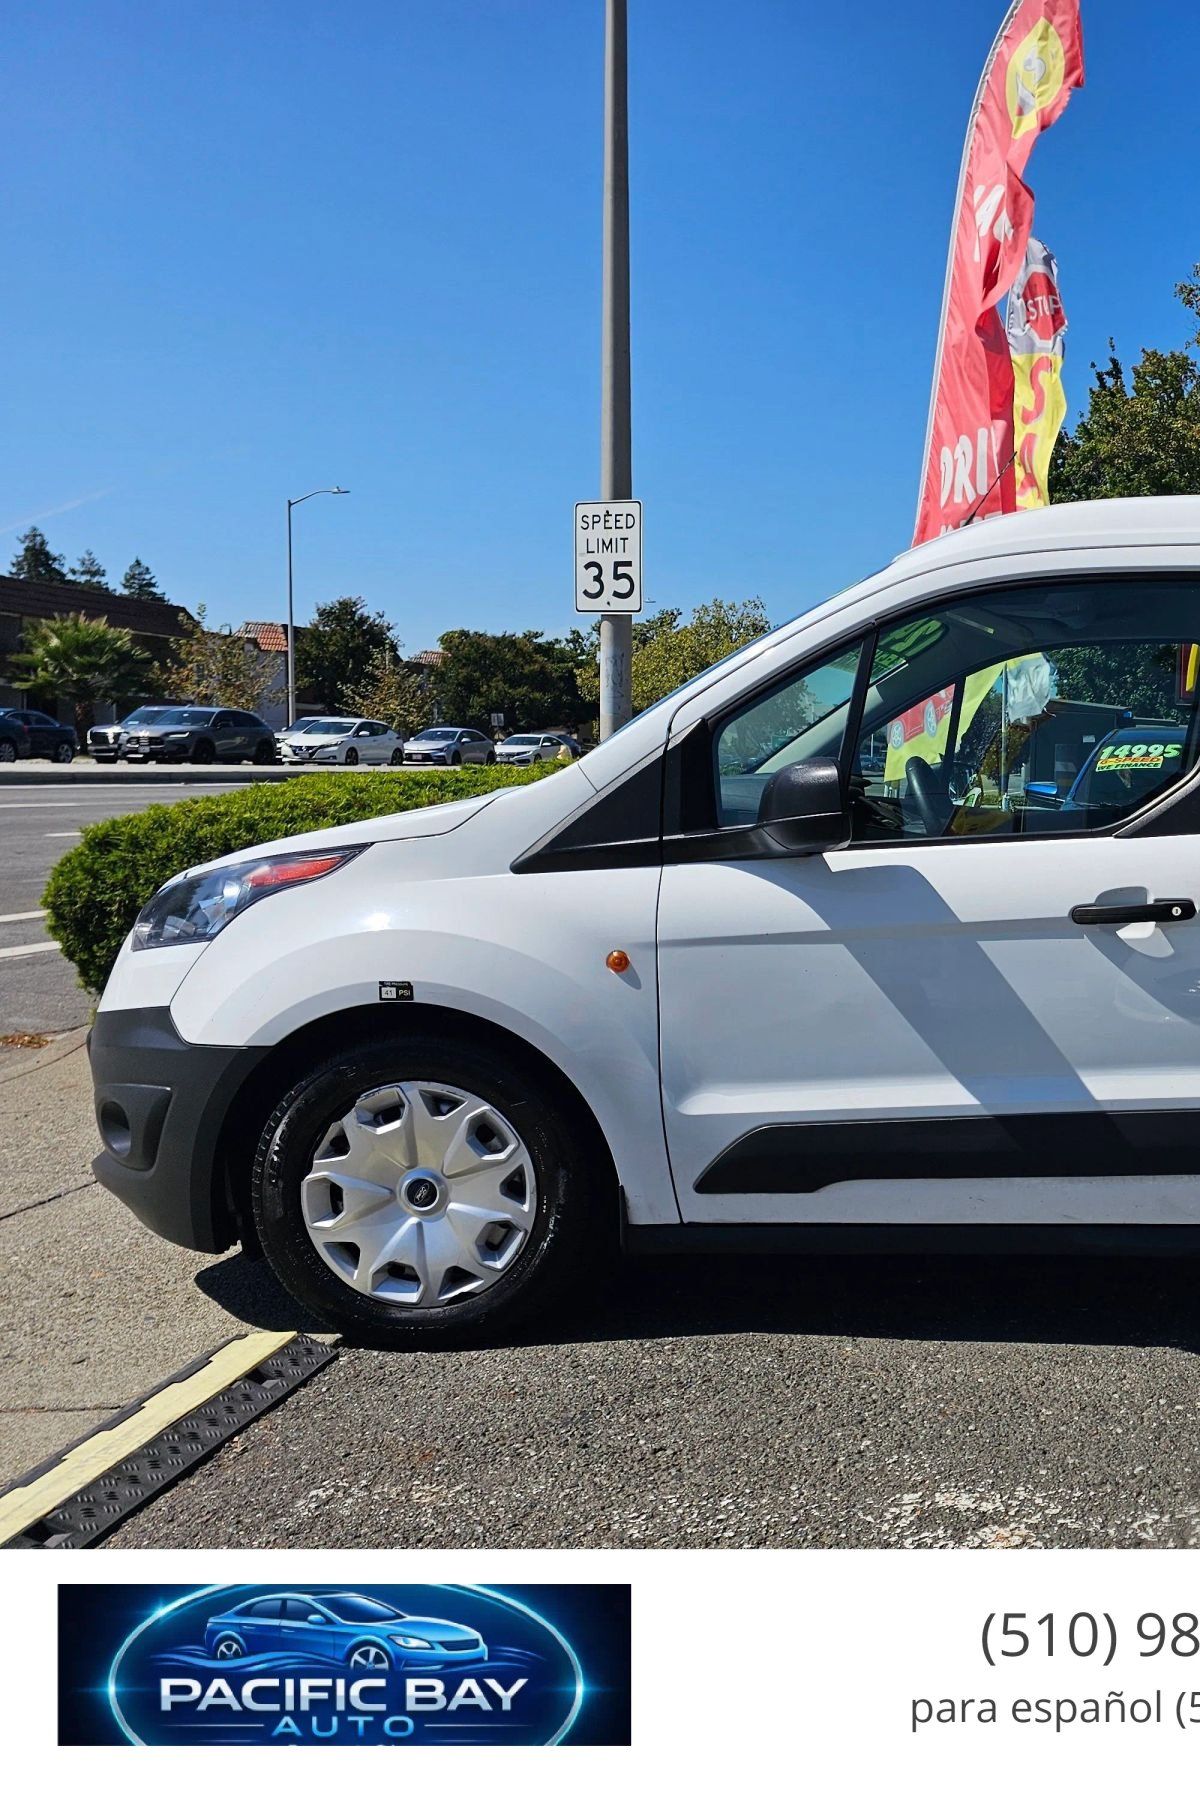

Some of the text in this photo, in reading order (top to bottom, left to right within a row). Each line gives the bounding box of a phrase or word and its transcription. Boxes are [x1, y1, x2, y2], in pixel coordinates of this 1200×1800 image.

[580, 513, 636, 530] SPEED
[586, 537, 629, 554] LIMIT
[582, 560, 635, 600] 35
[1099, 744, 1182, 760] 14995
